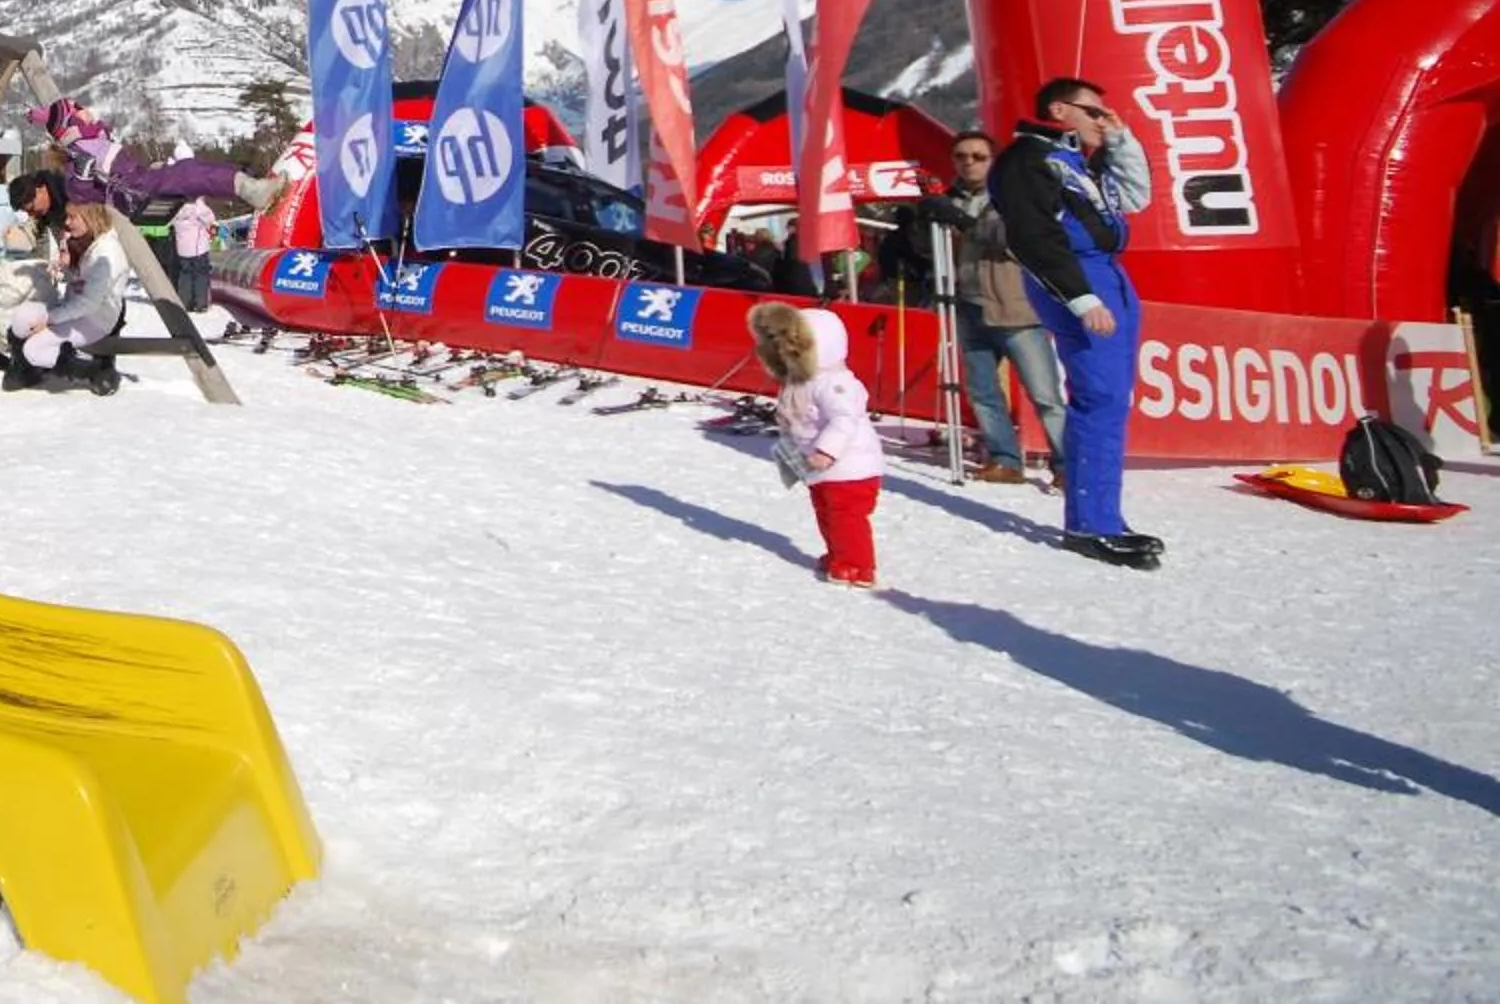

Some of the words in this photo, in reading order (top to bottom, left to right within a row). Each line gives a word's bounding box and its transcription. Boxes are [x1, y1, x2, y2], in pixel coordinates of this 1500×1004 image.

[276, 276, 319, 291] PEUGEOT
[489, 304, 545, 322] PEUGEOT
[620, 320, 685, 340] PEUGEOT
[1128, 339, 1380, 426] SSIGNOL
